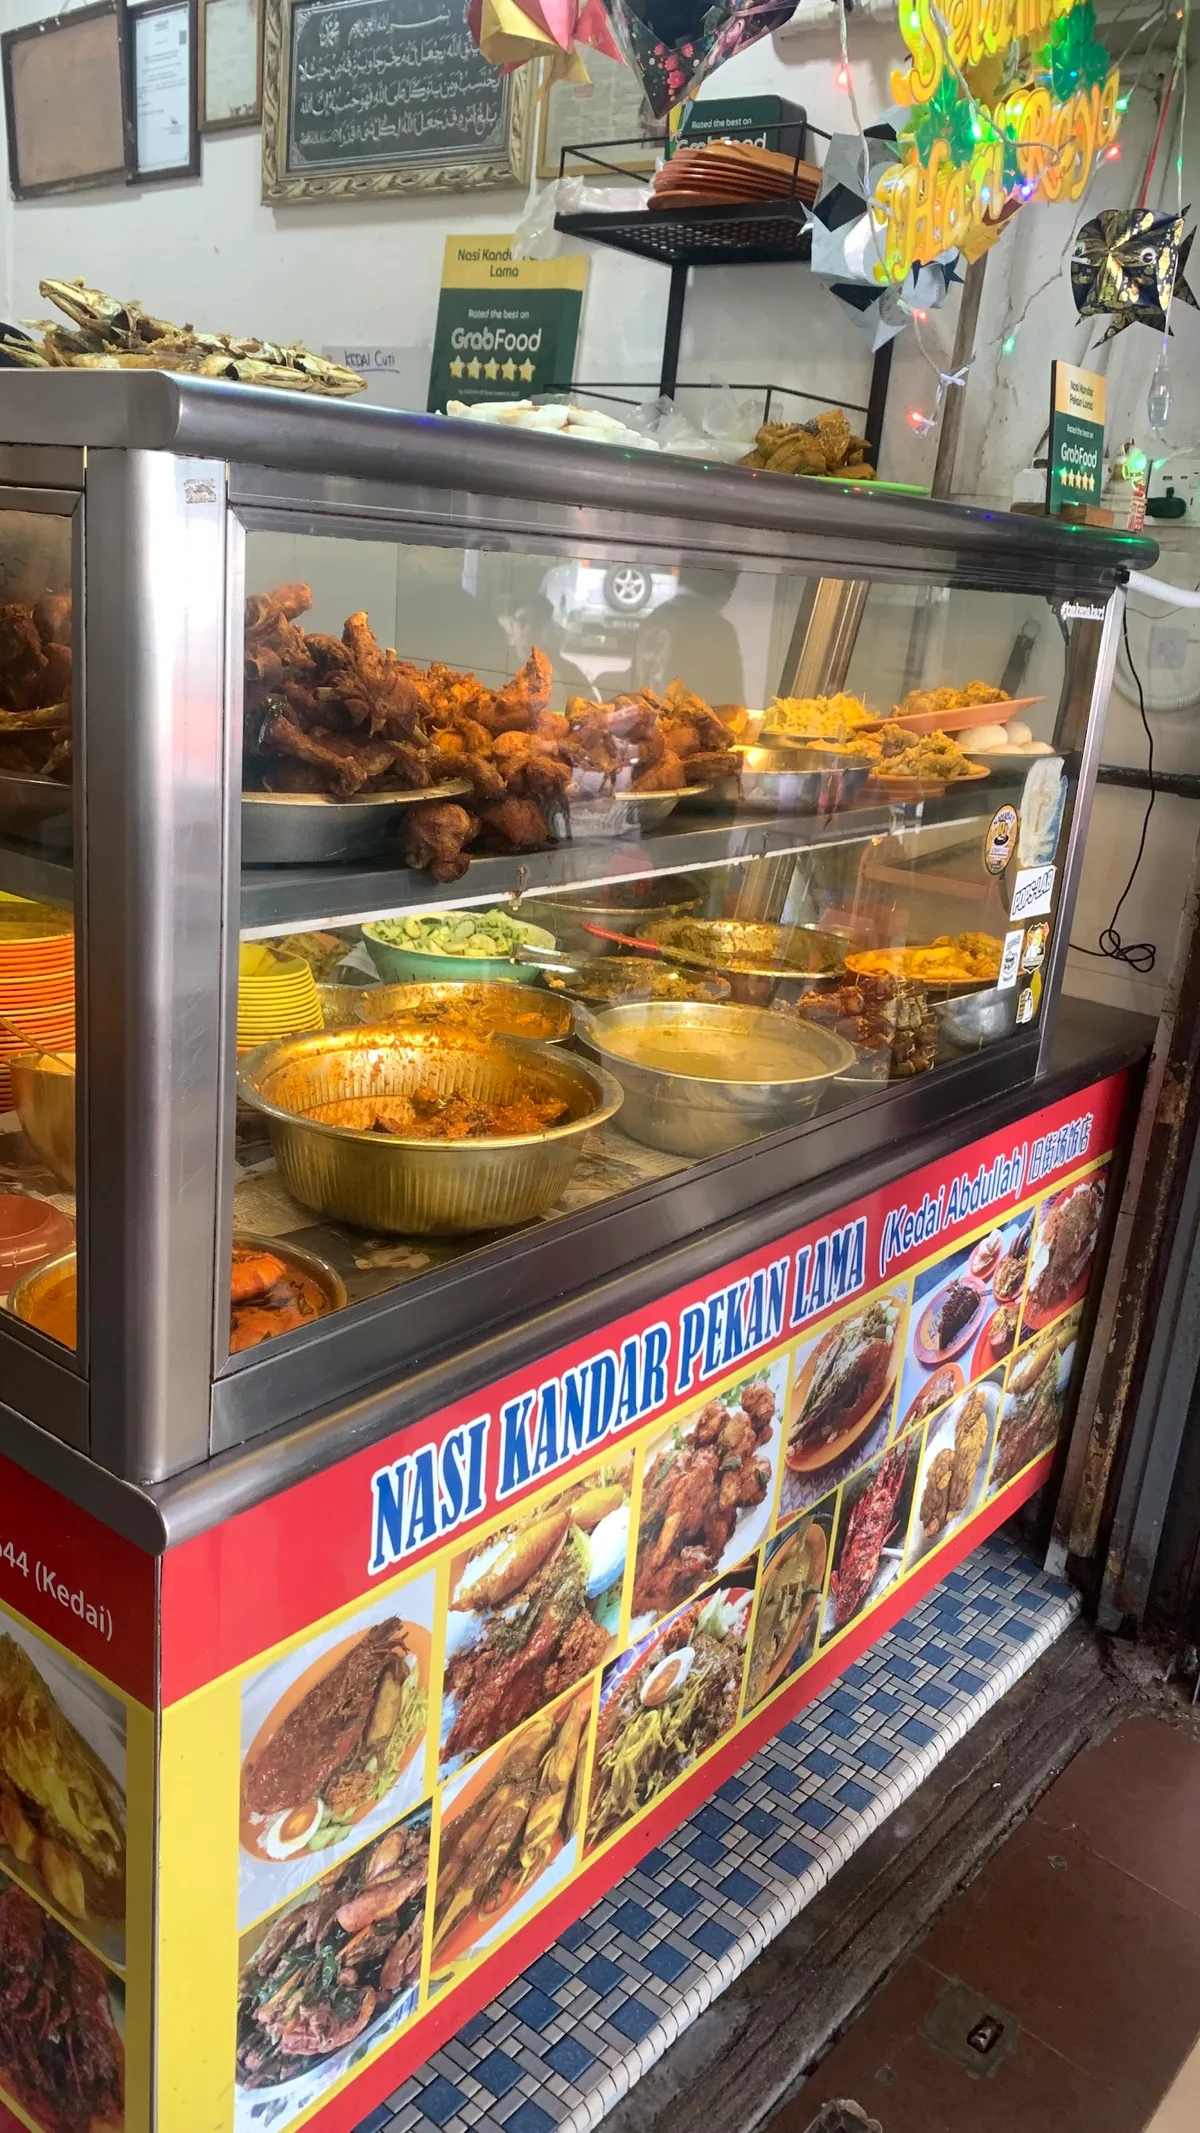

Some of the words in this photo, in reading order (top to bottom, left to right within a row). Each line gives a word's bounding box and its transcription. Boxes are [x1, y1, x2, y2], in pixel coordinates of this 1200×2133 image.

[691, 120, 712, 129] Rated
[713, 119, 725, 127] the
[726, 118, 742, 126] best
[457, 248, 480, 261] Nasi
[482, 247, 512, 261] Kand
[489, 264, 519, 278] Lama
[468, 309, 490, 319] Rated
[490, 309, 502, 319] the
[503, 309, 519, 320] best
[520, 311, 530, 319] on
[451, 327, 542, 352] GrabFood
[1061, 443, 1097, 468] GrabFood
[368, 1412, 491, 1575] NASI
[496, 1320, 671, 1500] KANDAR
[676, 1255, 790, 1394] PEKAN
[790, 1217, 867, 1330] LAMA
[880, 1185, 946, 1277] (Kedai
[944, 1142, 1028, 1230] Abdullah)
[0, 1541, 29, 1577] 44
[35, 1560, 113, 1642] (Kedai)
